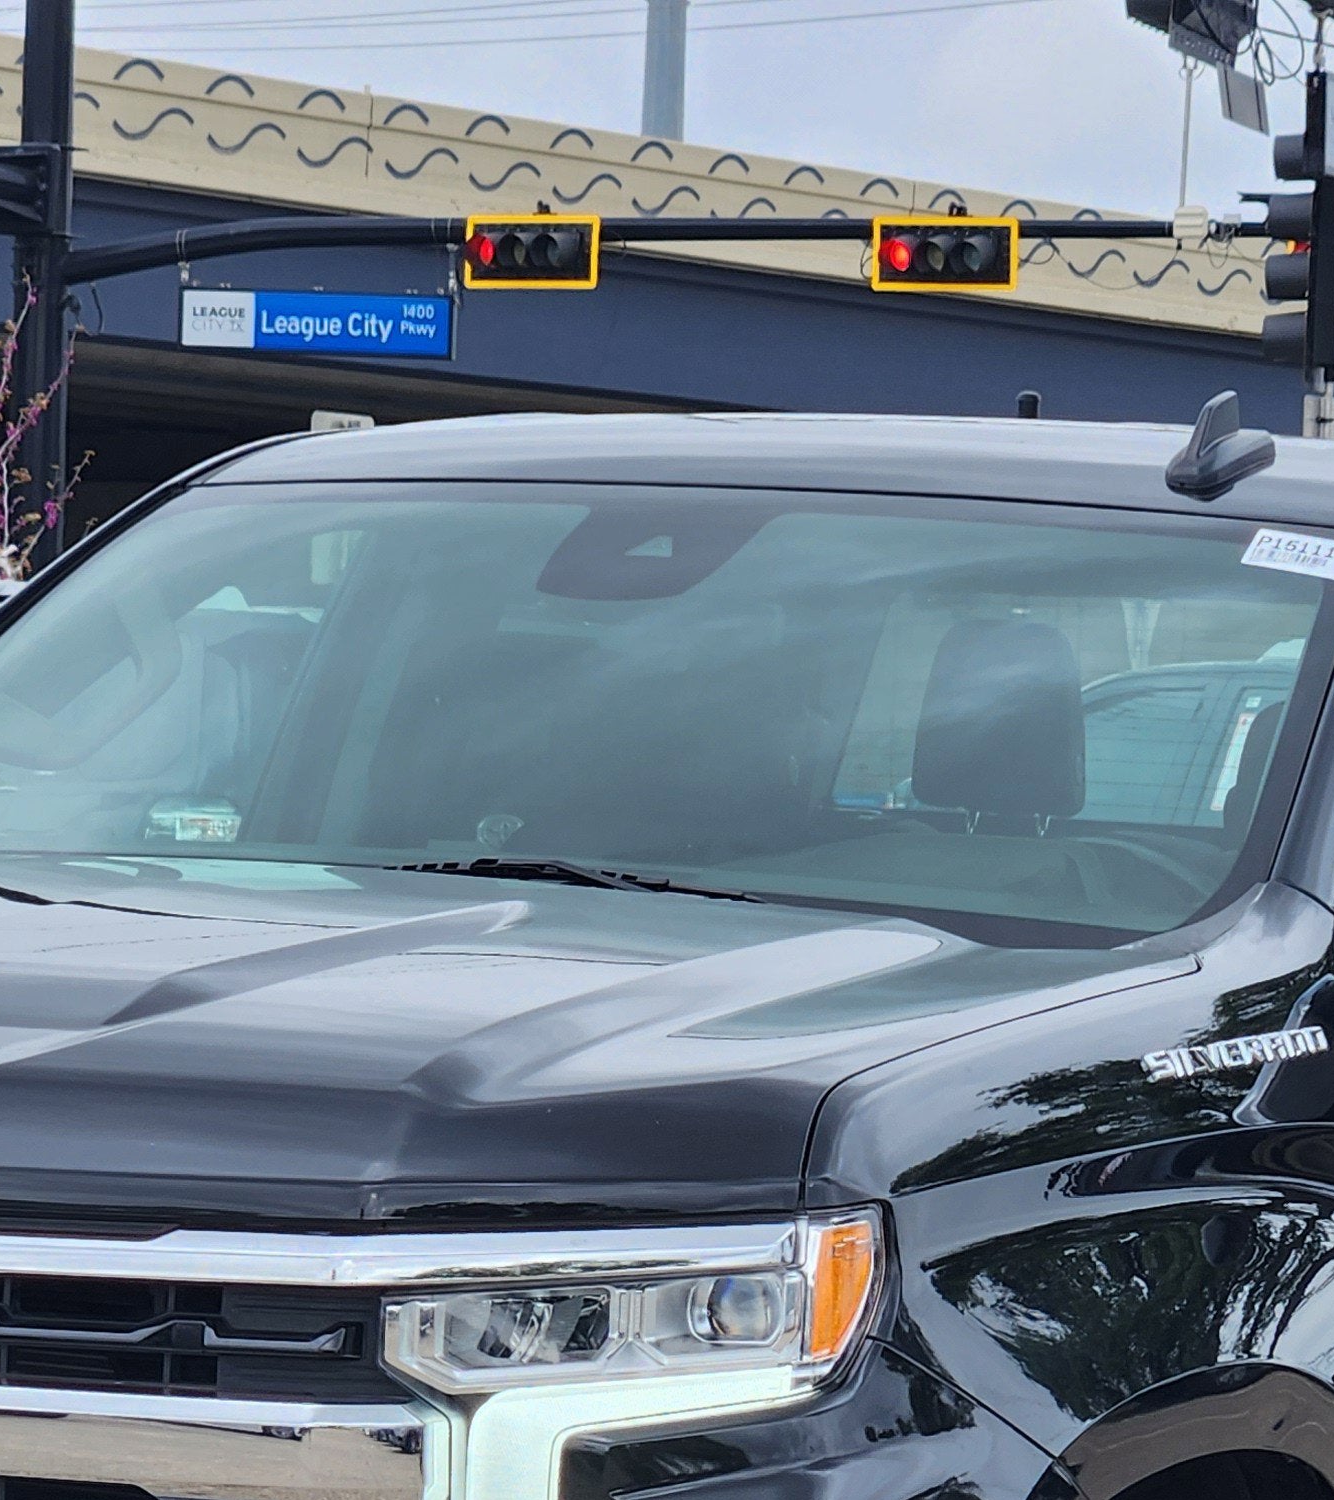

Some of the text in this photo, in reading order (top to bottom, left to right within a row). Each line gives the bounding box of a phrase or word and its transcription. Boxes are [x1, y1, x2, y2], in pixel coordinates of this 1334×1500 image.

[192, 305, 246, 319] LEAGUE
[402, 303, 435, 320] 1400
[191, 318, 223, 332] CITY
[260, 309, 394, 343] League City
[400, 320, 437, 339] Pkwy
[1140, 1025, 1330, 1084] SILVERADO
